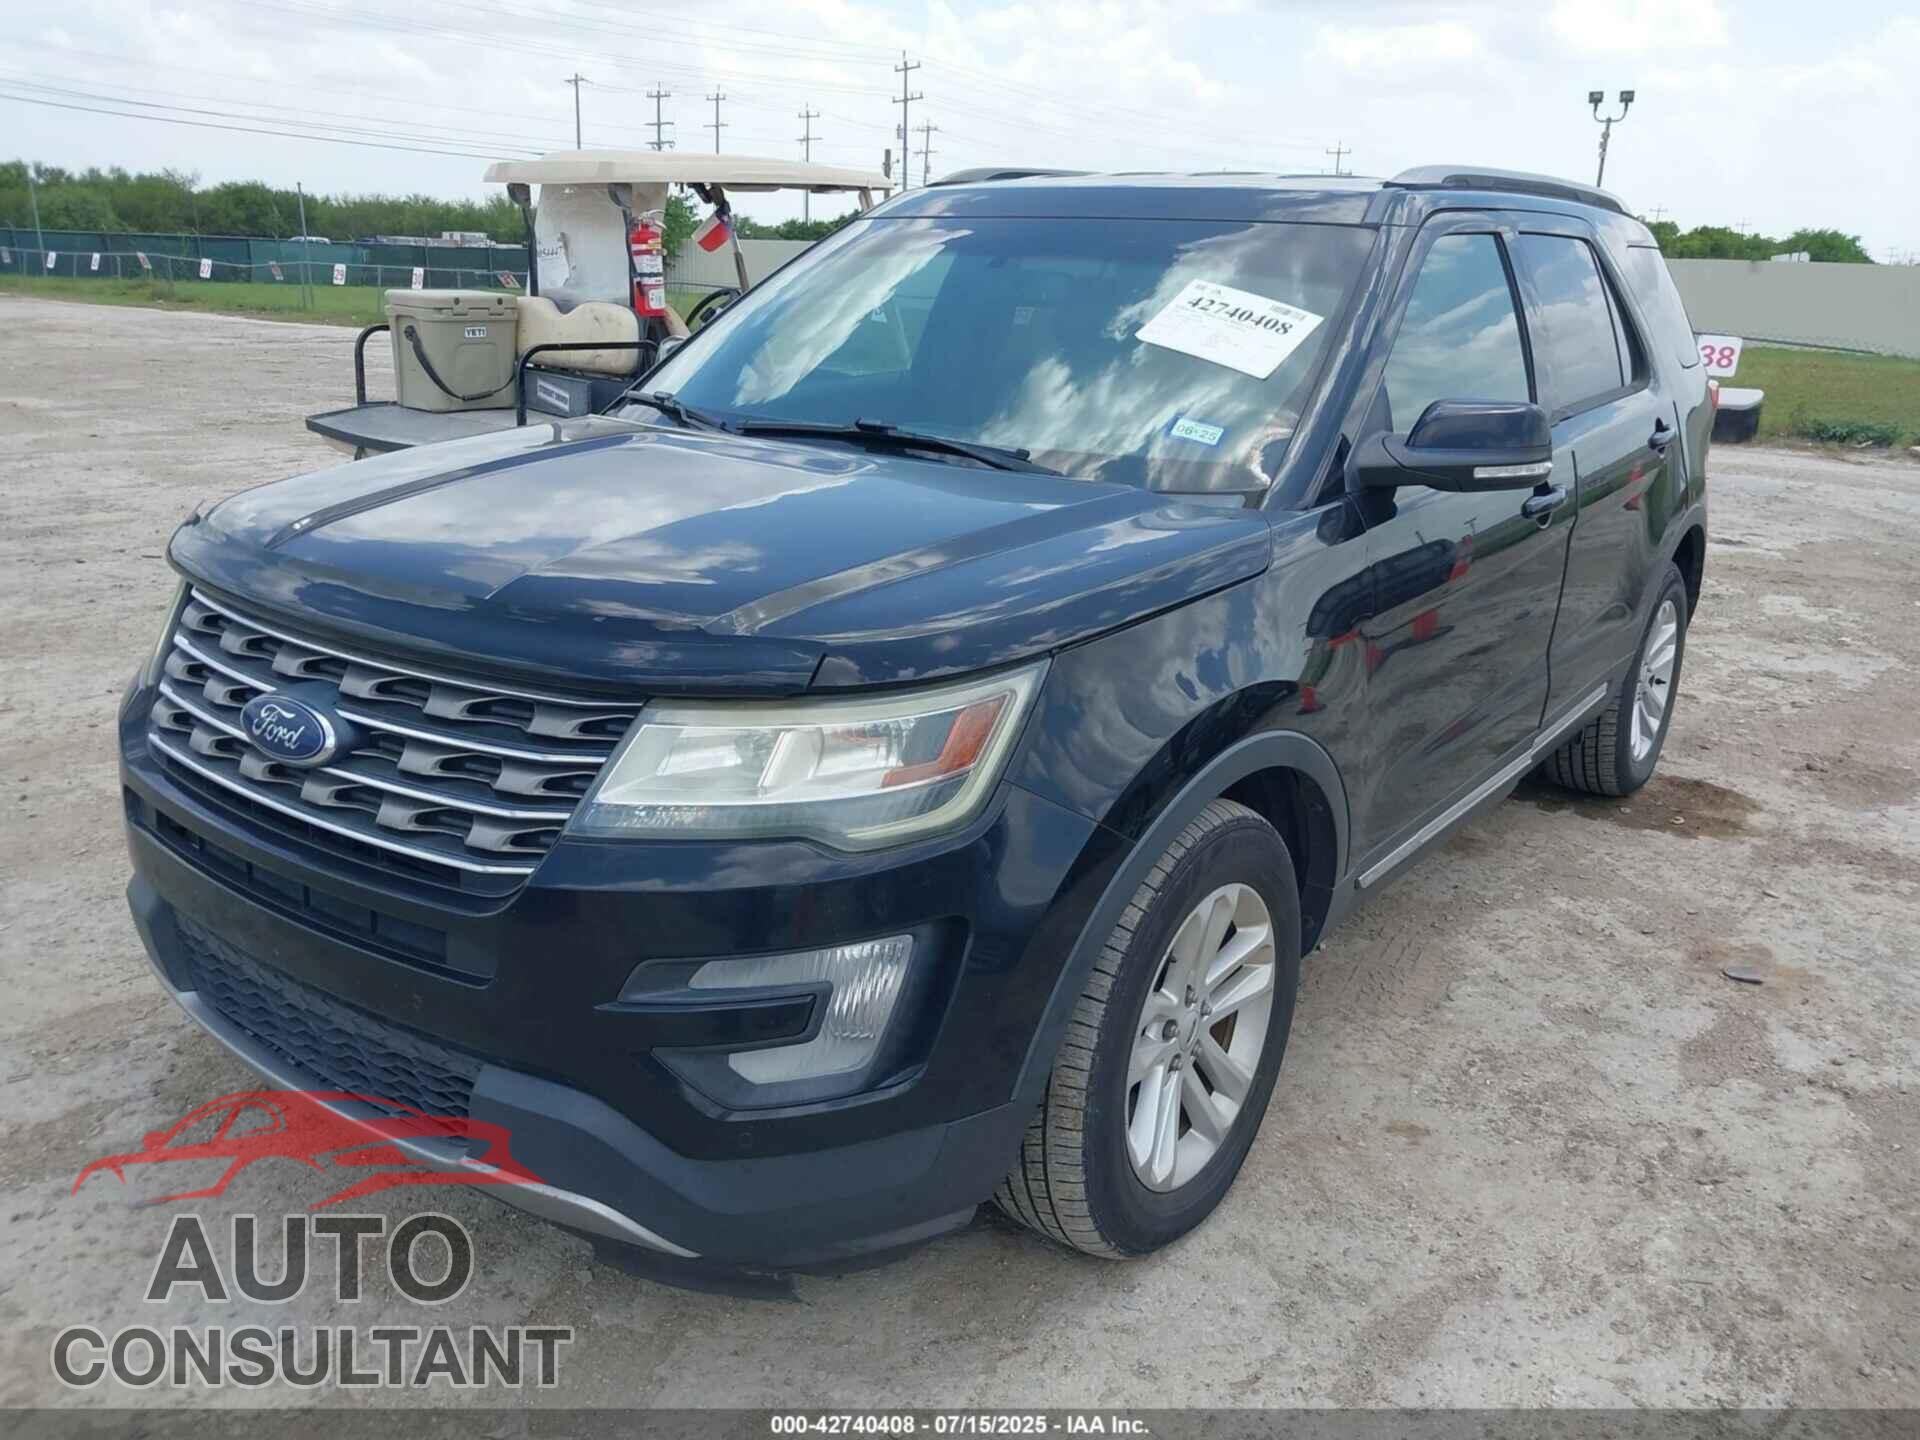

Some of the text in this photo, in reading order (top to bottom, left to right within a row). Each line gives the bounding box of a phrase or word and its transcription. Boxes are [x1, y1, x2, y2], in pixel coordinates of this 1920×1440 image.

[1188, 296, 1293, 335] 42740408
[465, 328, 487, 337] YETI
[1700, 344, 1735, 369] 38
[252, 703, 305, 750] Ford
